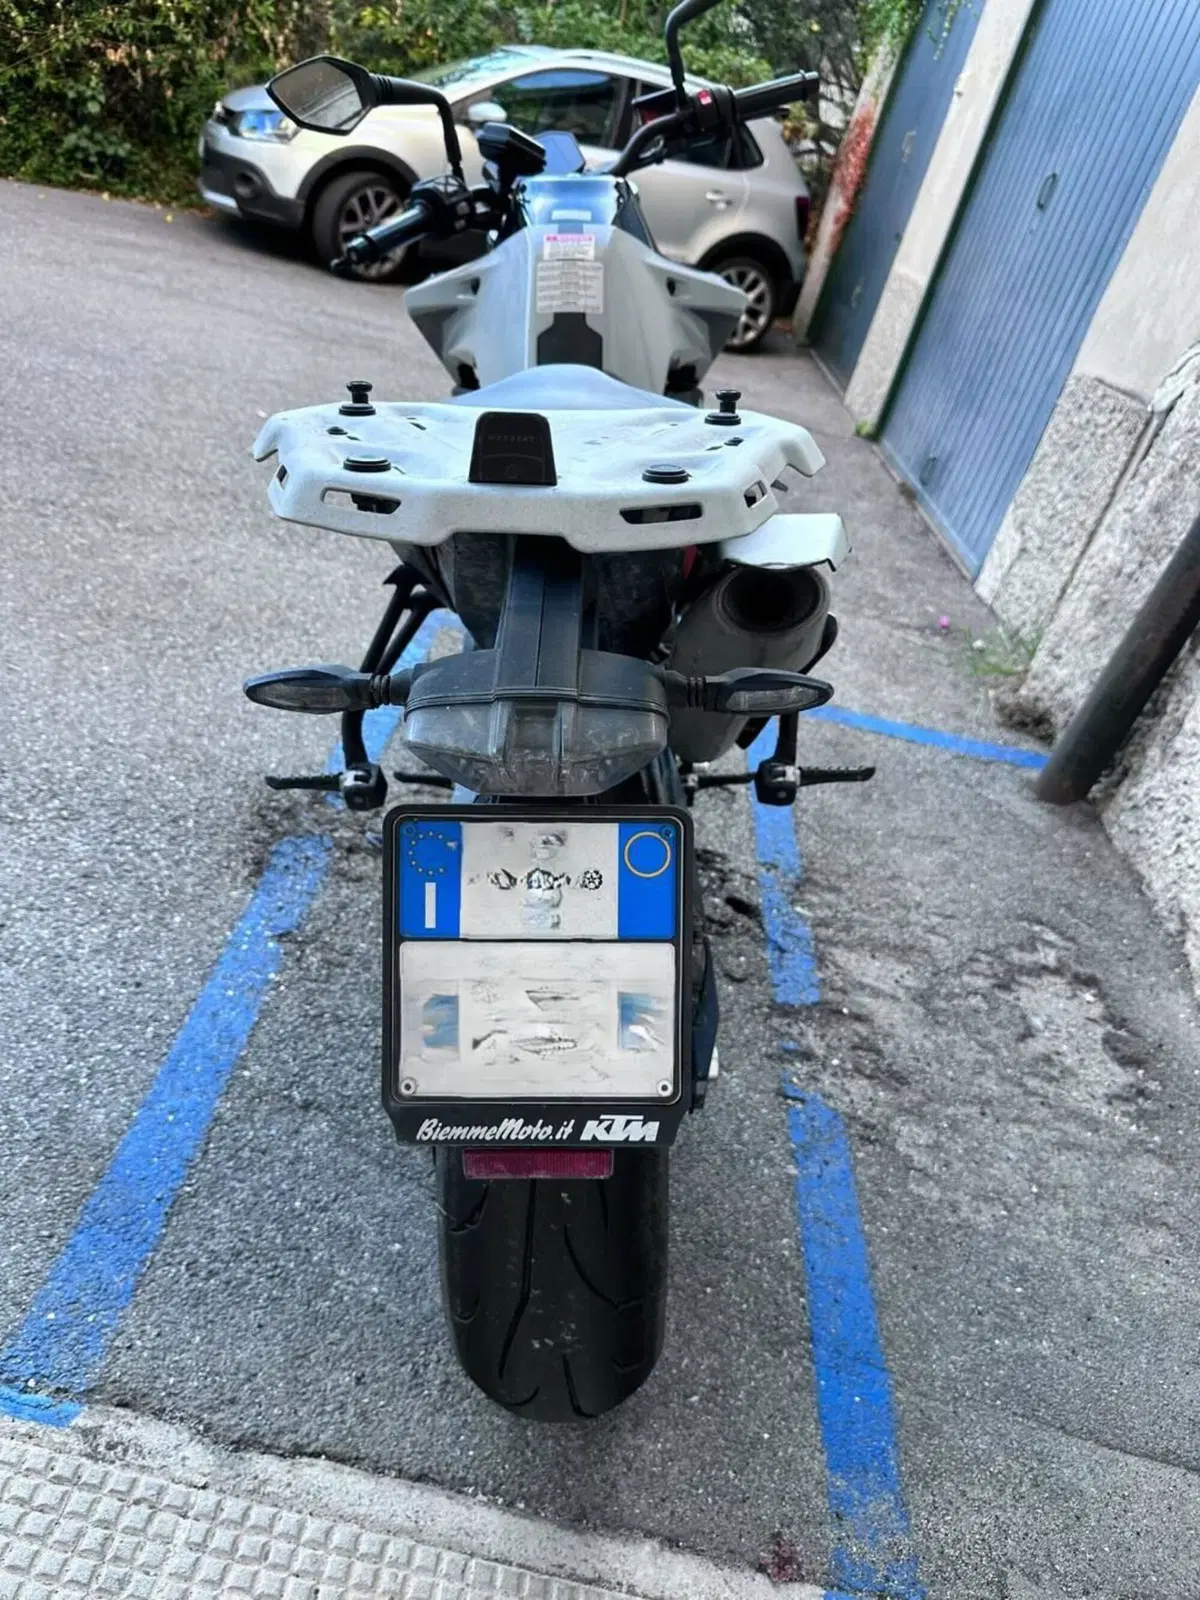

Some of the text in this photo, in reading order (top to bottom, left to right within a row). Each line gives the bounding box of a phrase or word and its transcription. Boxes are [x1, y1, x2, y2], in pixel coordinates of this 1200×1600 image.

[424, 881, 437, 929] I
[416, 1114, 660, 1142] BiemmeMoto.it KTM
